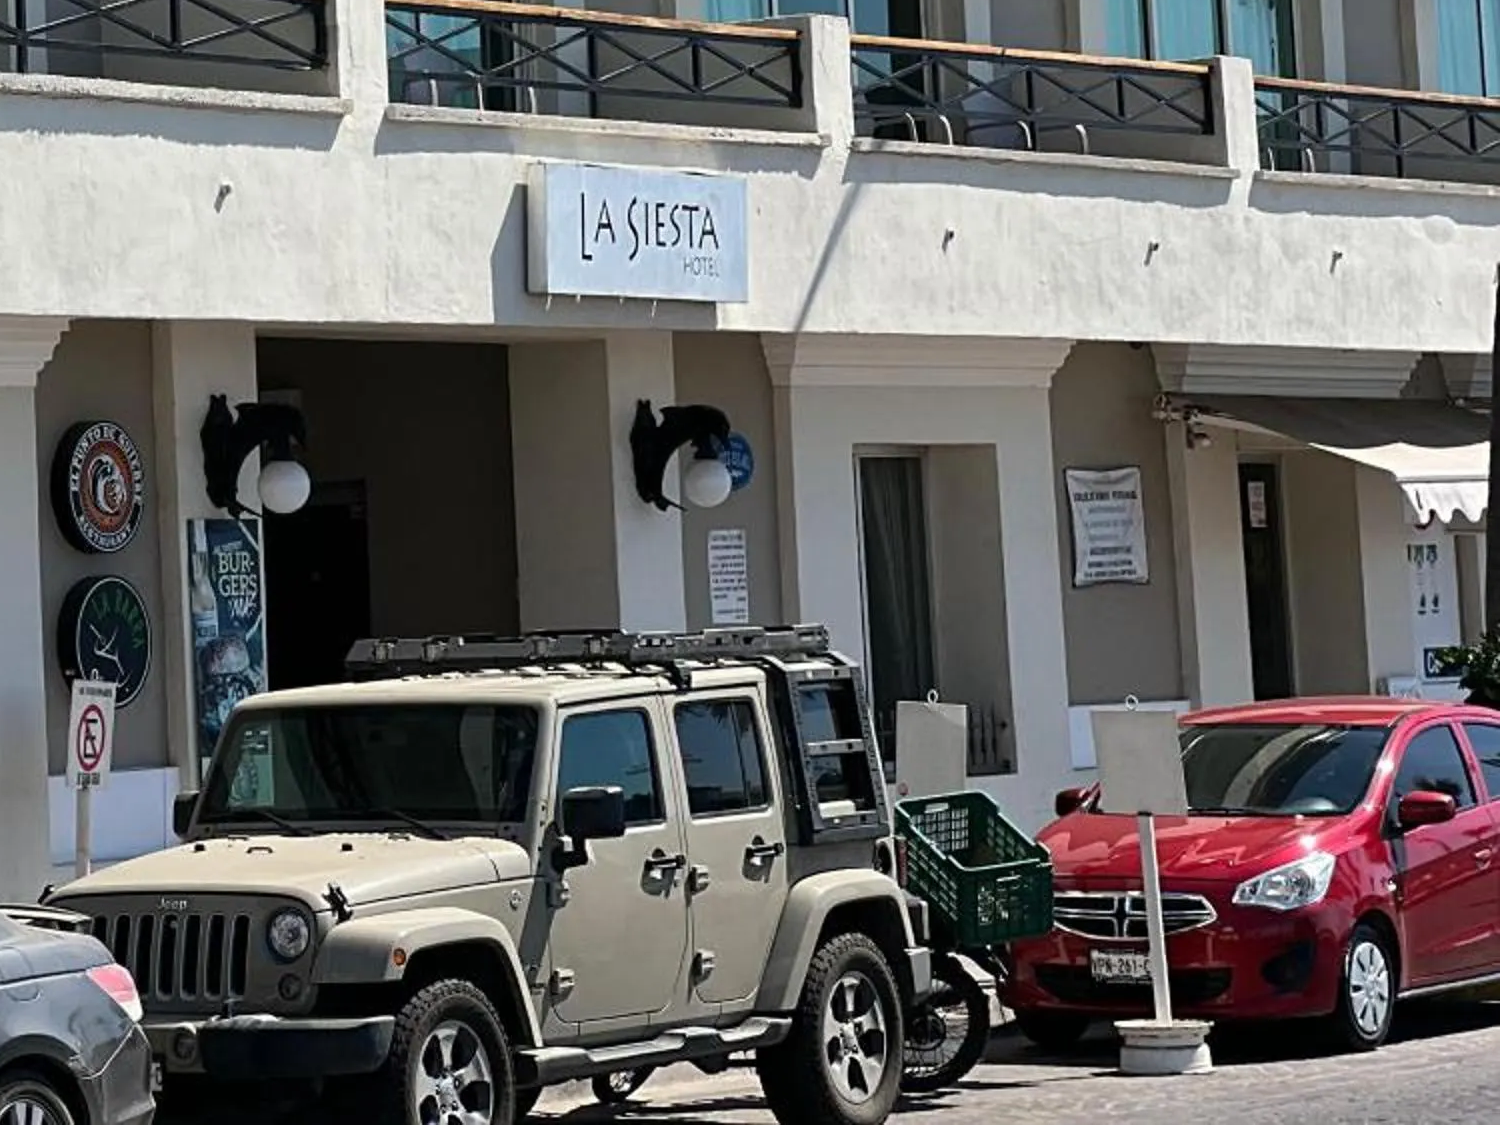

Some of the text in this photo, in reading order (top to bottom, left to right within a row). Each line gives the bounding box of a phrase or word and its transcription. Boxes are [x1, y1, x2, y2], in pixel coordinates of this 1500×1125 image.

[581, 191, 720, 262] LA SIESTA
[683, 256, 721, 277] HOTEL
[218, 550, 256, 574] BUR-
[218, 573, 259, 598] GERS
[156, 895, 188, 911] Jeep
